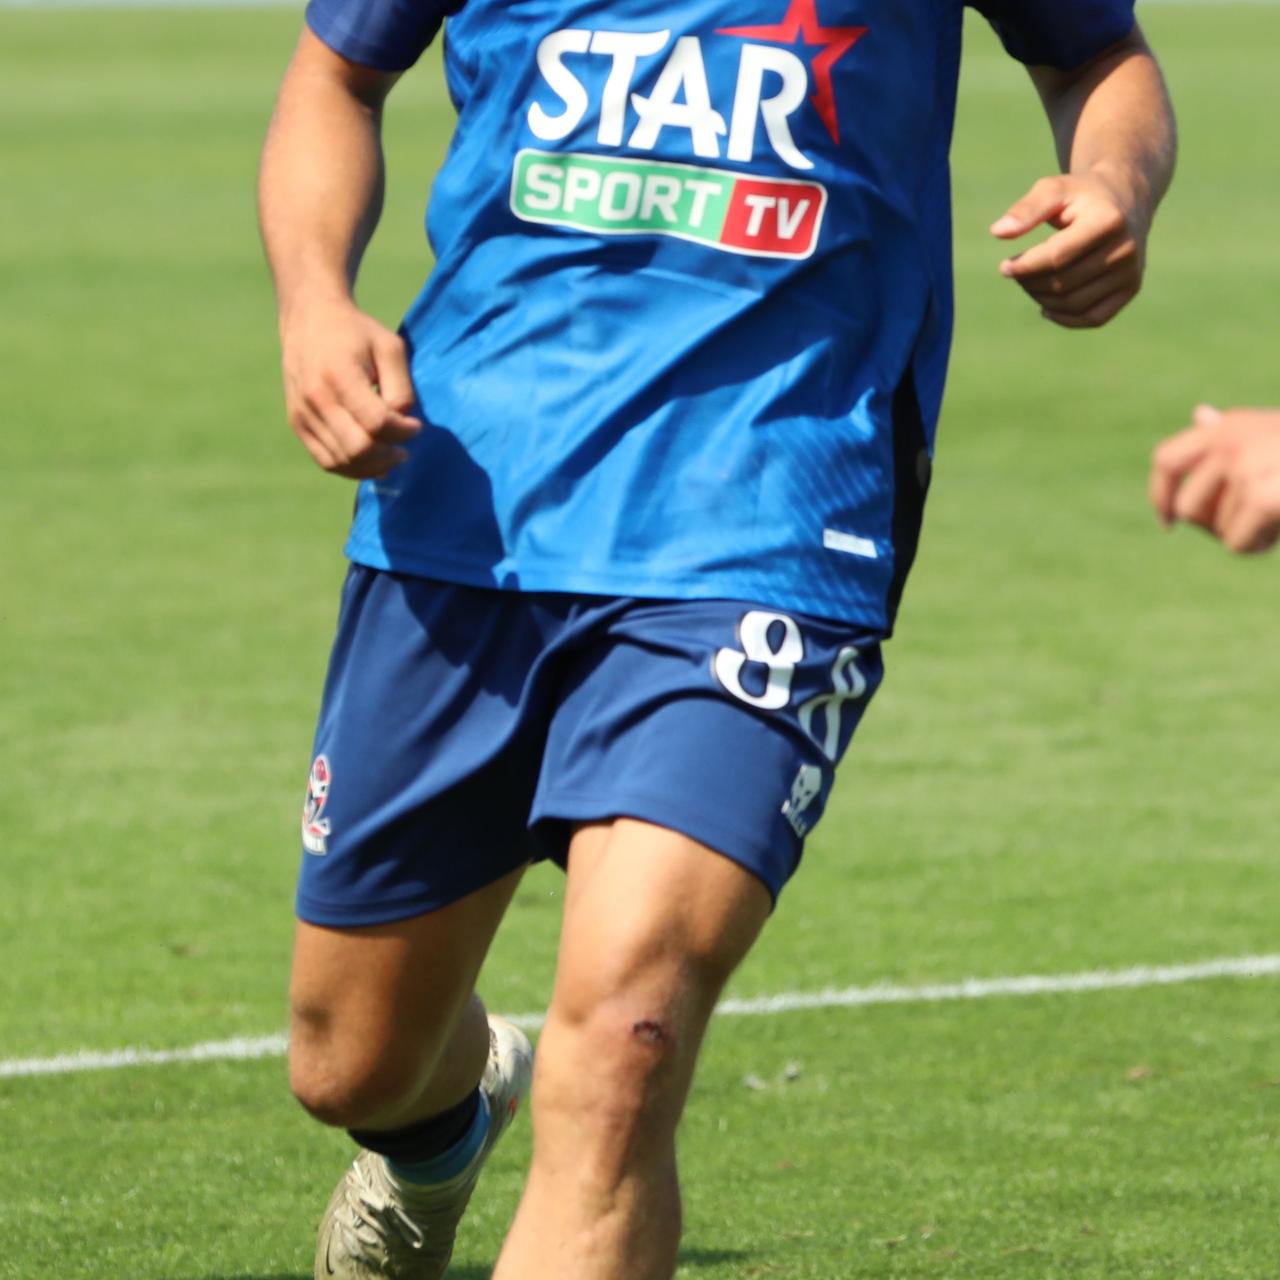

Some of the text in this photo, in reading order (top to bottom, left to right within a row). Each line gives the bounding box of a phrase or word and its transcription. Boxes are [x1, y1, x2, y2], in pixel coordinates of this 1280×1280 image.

[527, 29, 815, 170] STAR
[523, 162, 811, 240] SPORT TV
